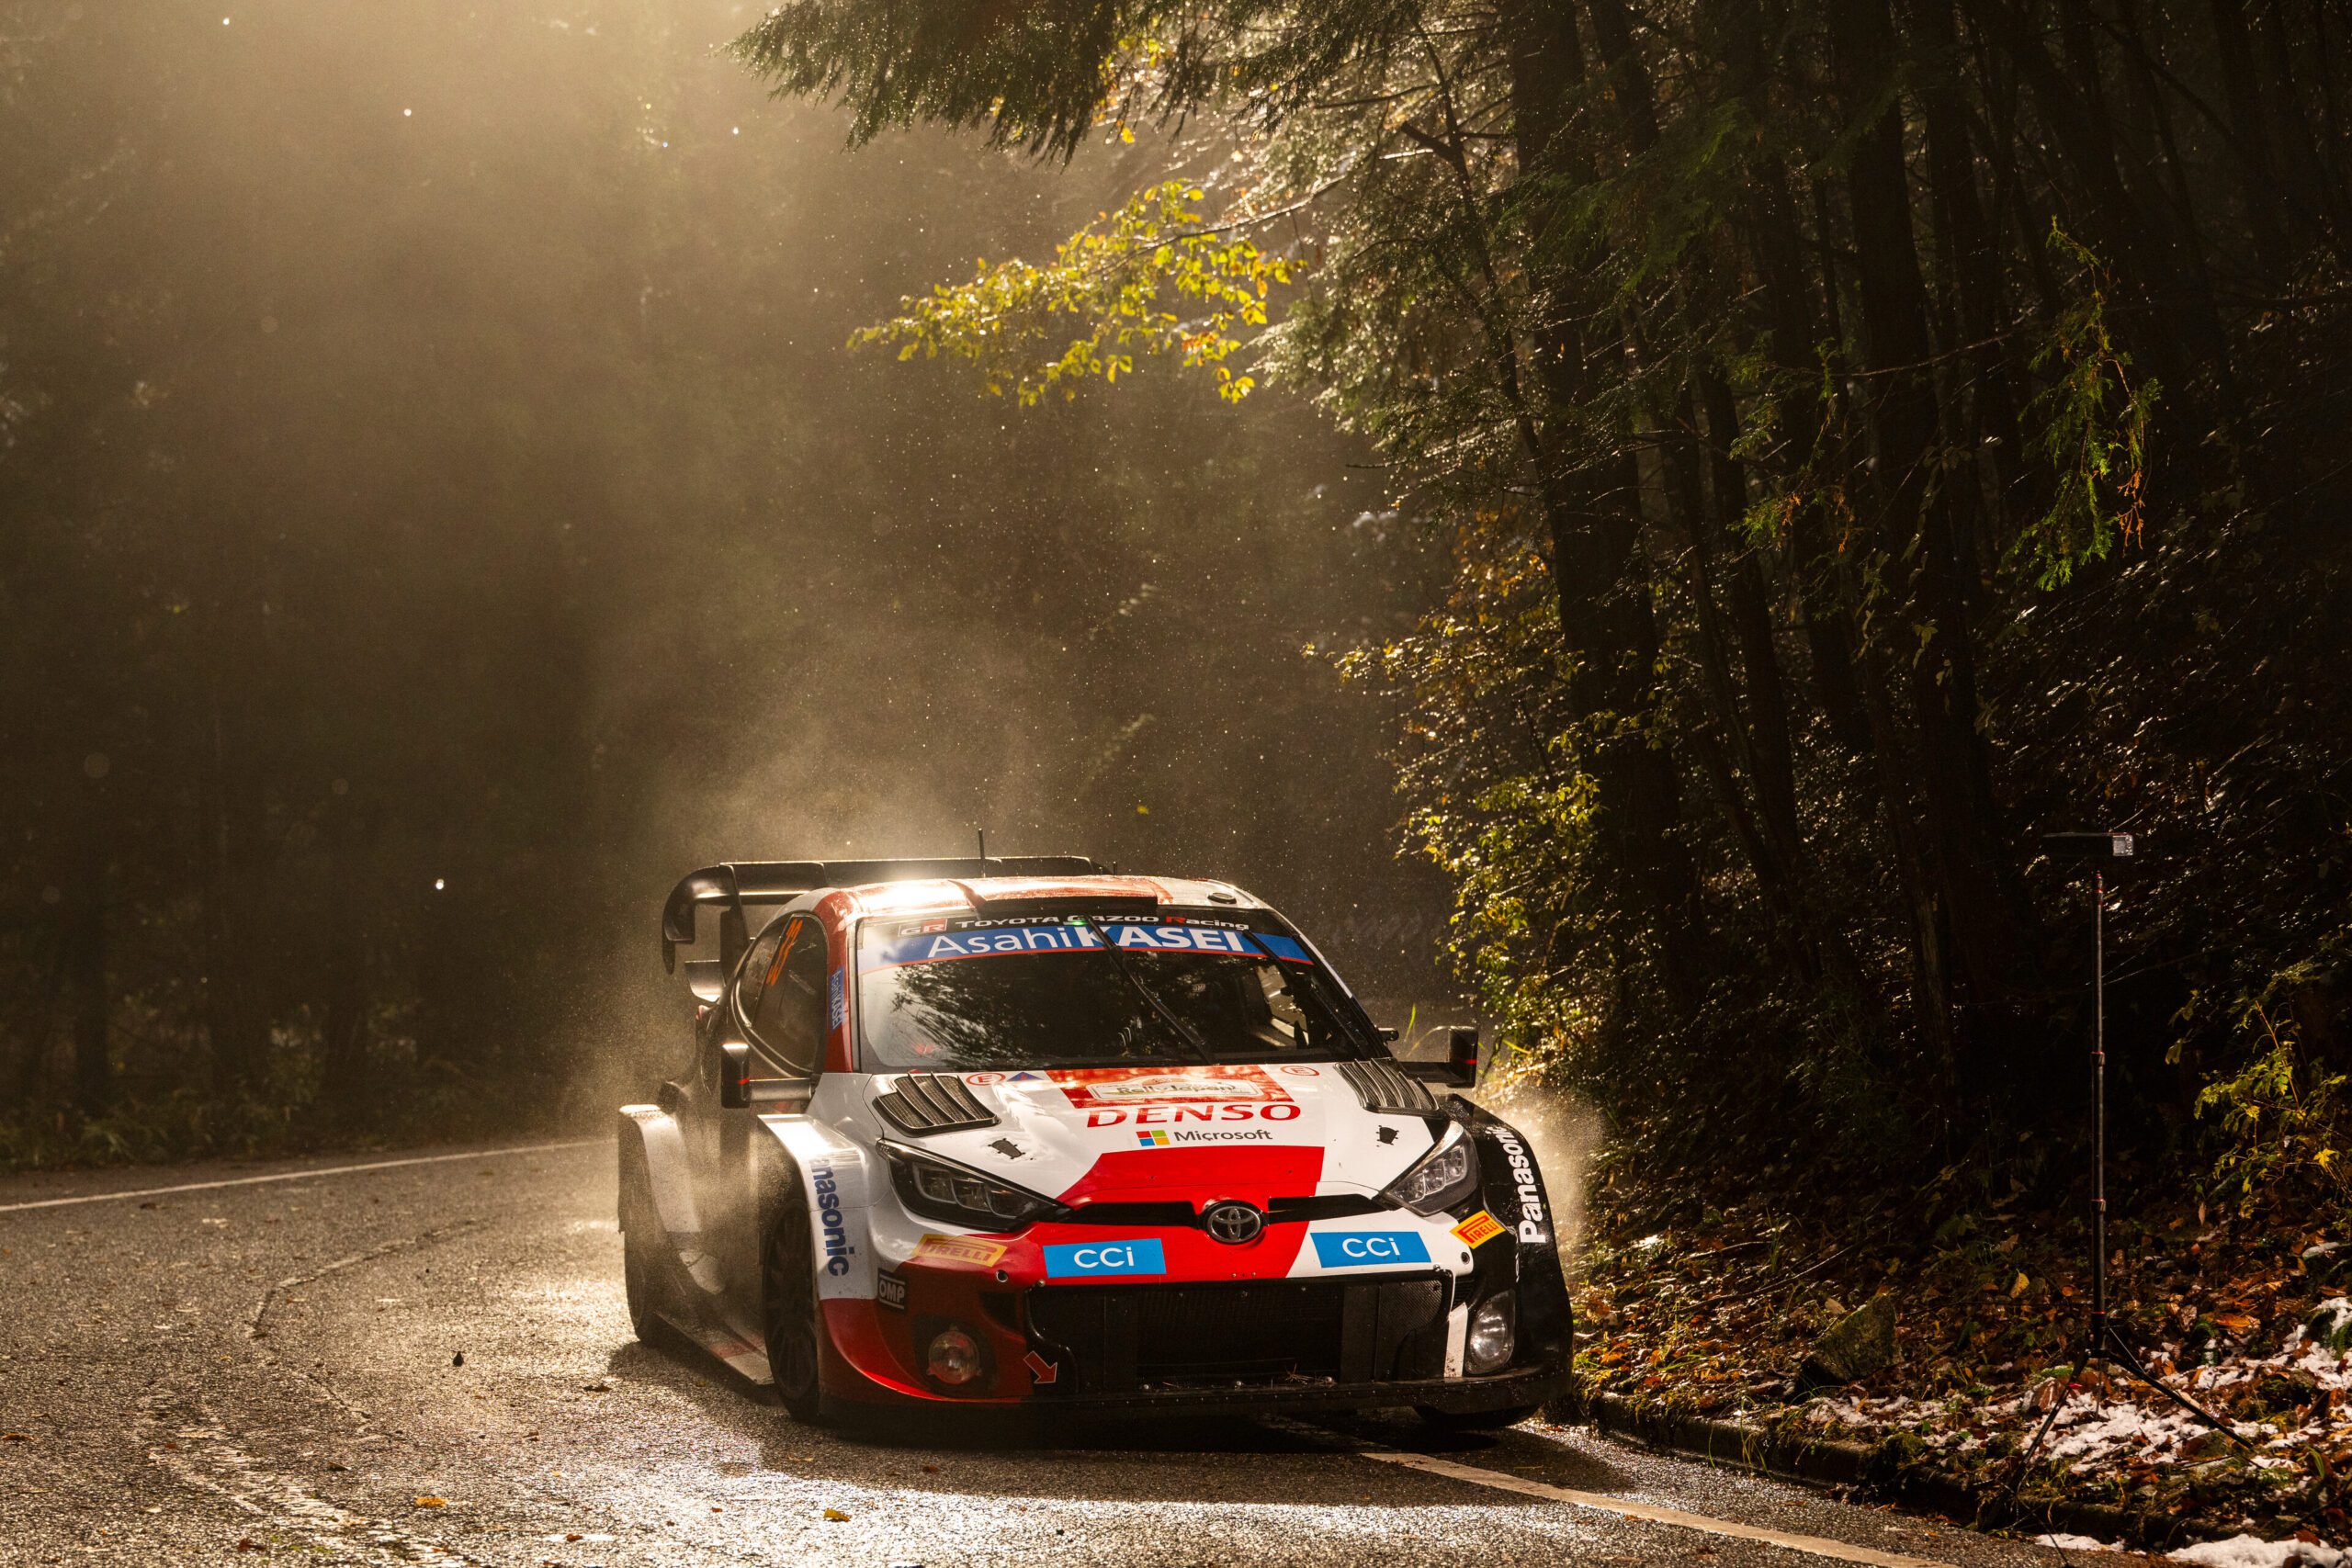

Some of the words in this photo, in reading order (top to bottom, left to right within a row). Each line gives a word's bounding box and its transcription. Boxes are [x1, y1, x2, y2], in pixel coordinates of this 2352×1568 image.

[900, 923, 946, 935] GR
[956, 917, 1059, 928] TOYOTA
[1068, 915, 1159, 923] GAZOO
[1166, 916, 1250, 931] Racing
[927, 926, 1245, 958] AsahiKASEI
[1087, 1104, 1301, 1128] DENSO
[1174, 1129, 1272, 1142] Microsoft
[1485, 1126, 1546, 1243] Panasonic
[808, 1159, 854, 1277] nasonic
[1457, 1214, 1499, 1244] PIRELLI
[919, 1238, 997, 1261] PIRELLI
[878, 1282, 905, 1303] OMP
